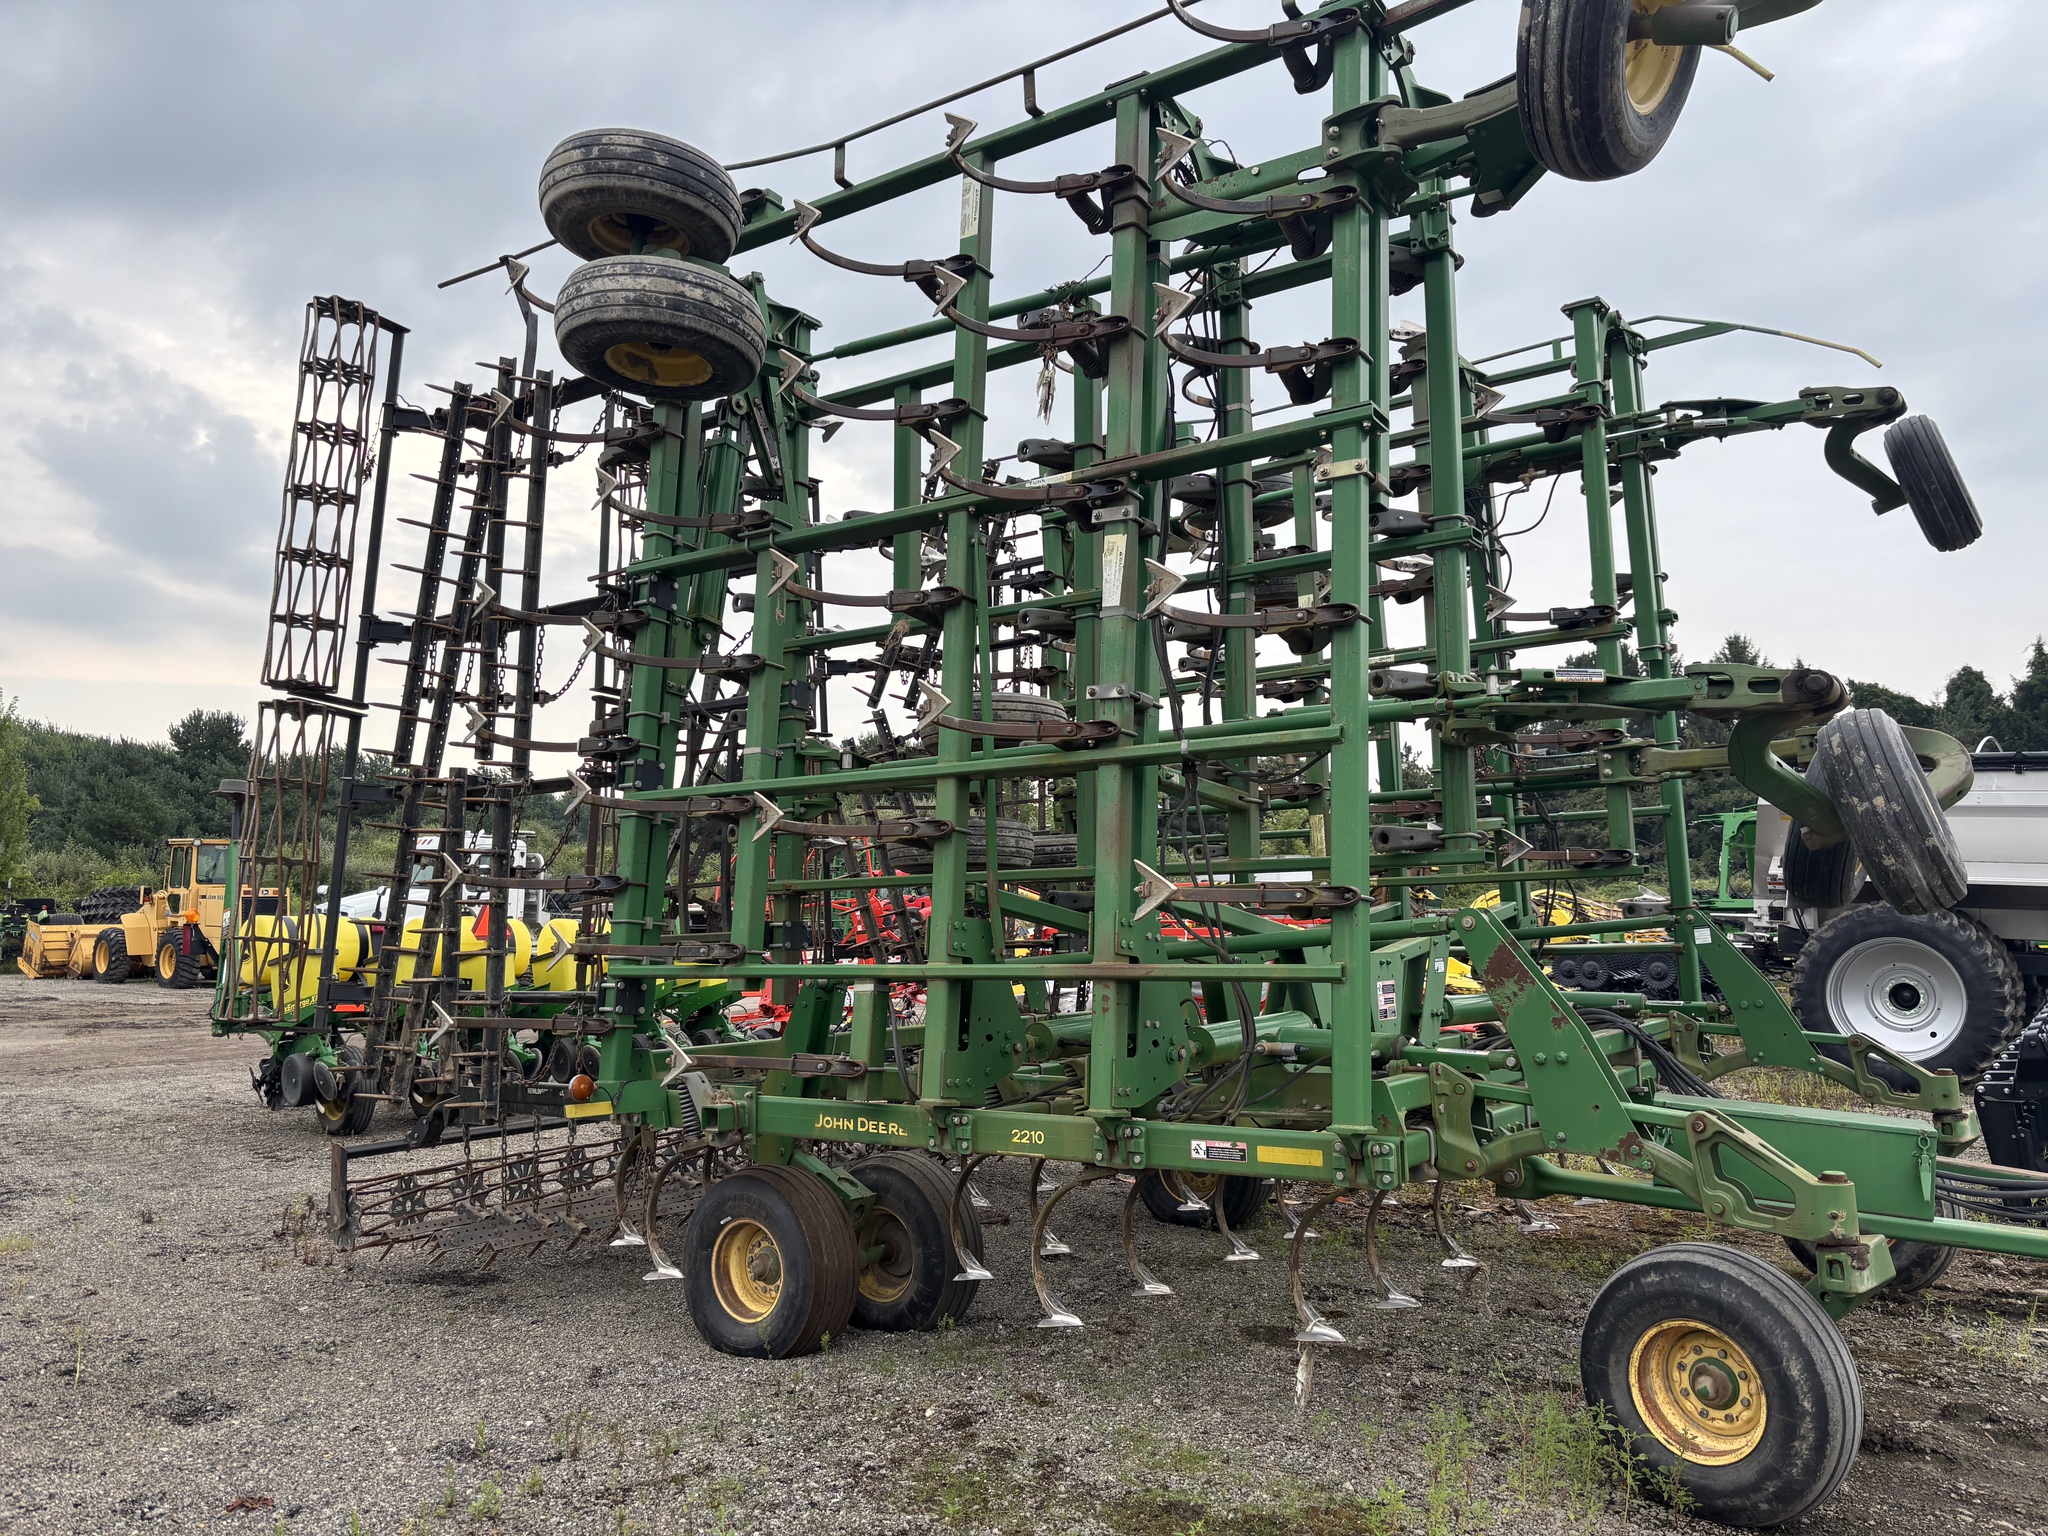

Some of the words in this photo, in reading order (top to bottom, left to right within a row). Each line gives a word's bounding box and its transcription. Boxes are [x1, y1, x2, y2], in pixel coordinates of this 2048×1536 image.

[814, 1113, 854, 1131] JOHN
[857, 1117, 908, 1137] DEERE
[1011, 1129, 1045, 1145] 2210
